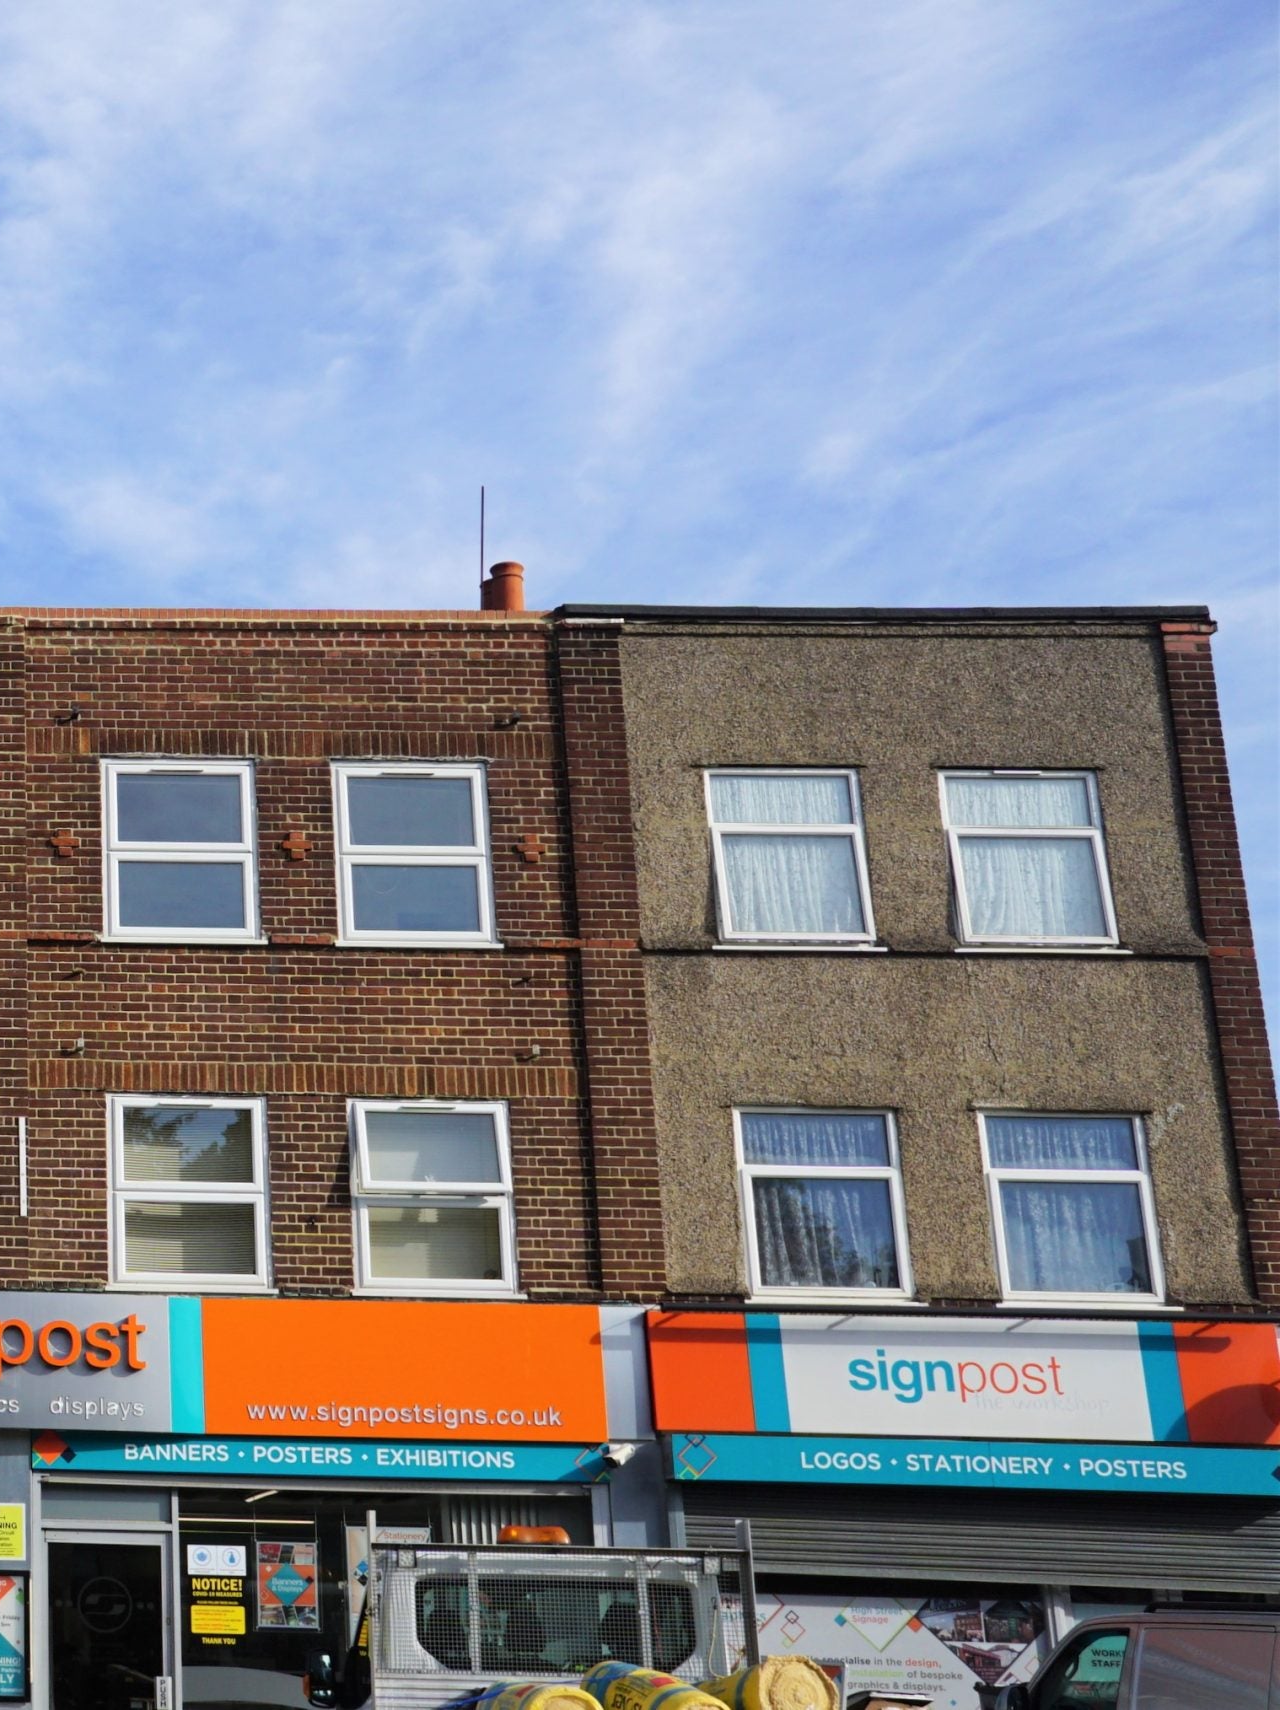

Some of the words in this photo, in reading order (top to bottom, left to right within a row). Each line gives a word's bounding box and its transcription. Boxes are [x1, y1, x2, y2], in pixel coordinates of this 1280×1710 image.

[847, 1348, 1065, 1404] signpost
[49, 1396, 146, 1421] displays
[246, 1401, 563, 1429] www.signpostsigns.co.uk
[123, 1443, 230, 1462] BANNERS
[252, 1445, 353, 1465] POSTERS
[375, 1448, 516, 1470] EXHIBITIONS
[800, 1451, 882, 1472] LOGOS
[906, 1454, 1054, 1476] STATIONERY
[1079, 1458, 1188, 1480] POSTERS
[191, 1578, 243, 1591] NOTICE!
[201, 1637, 222, 1645] THANK
[223, 1637, 237, 1646] YOU
[873, 1656, 883, 1666] in
[885, 1657, 903, 1667] the
[847, 1679, 890, 1692] graphics
[892, 1681, 900, 1690] &
[907, 1669, 919, 1679] of
[919, 1670, 963, 1683] bespoke
